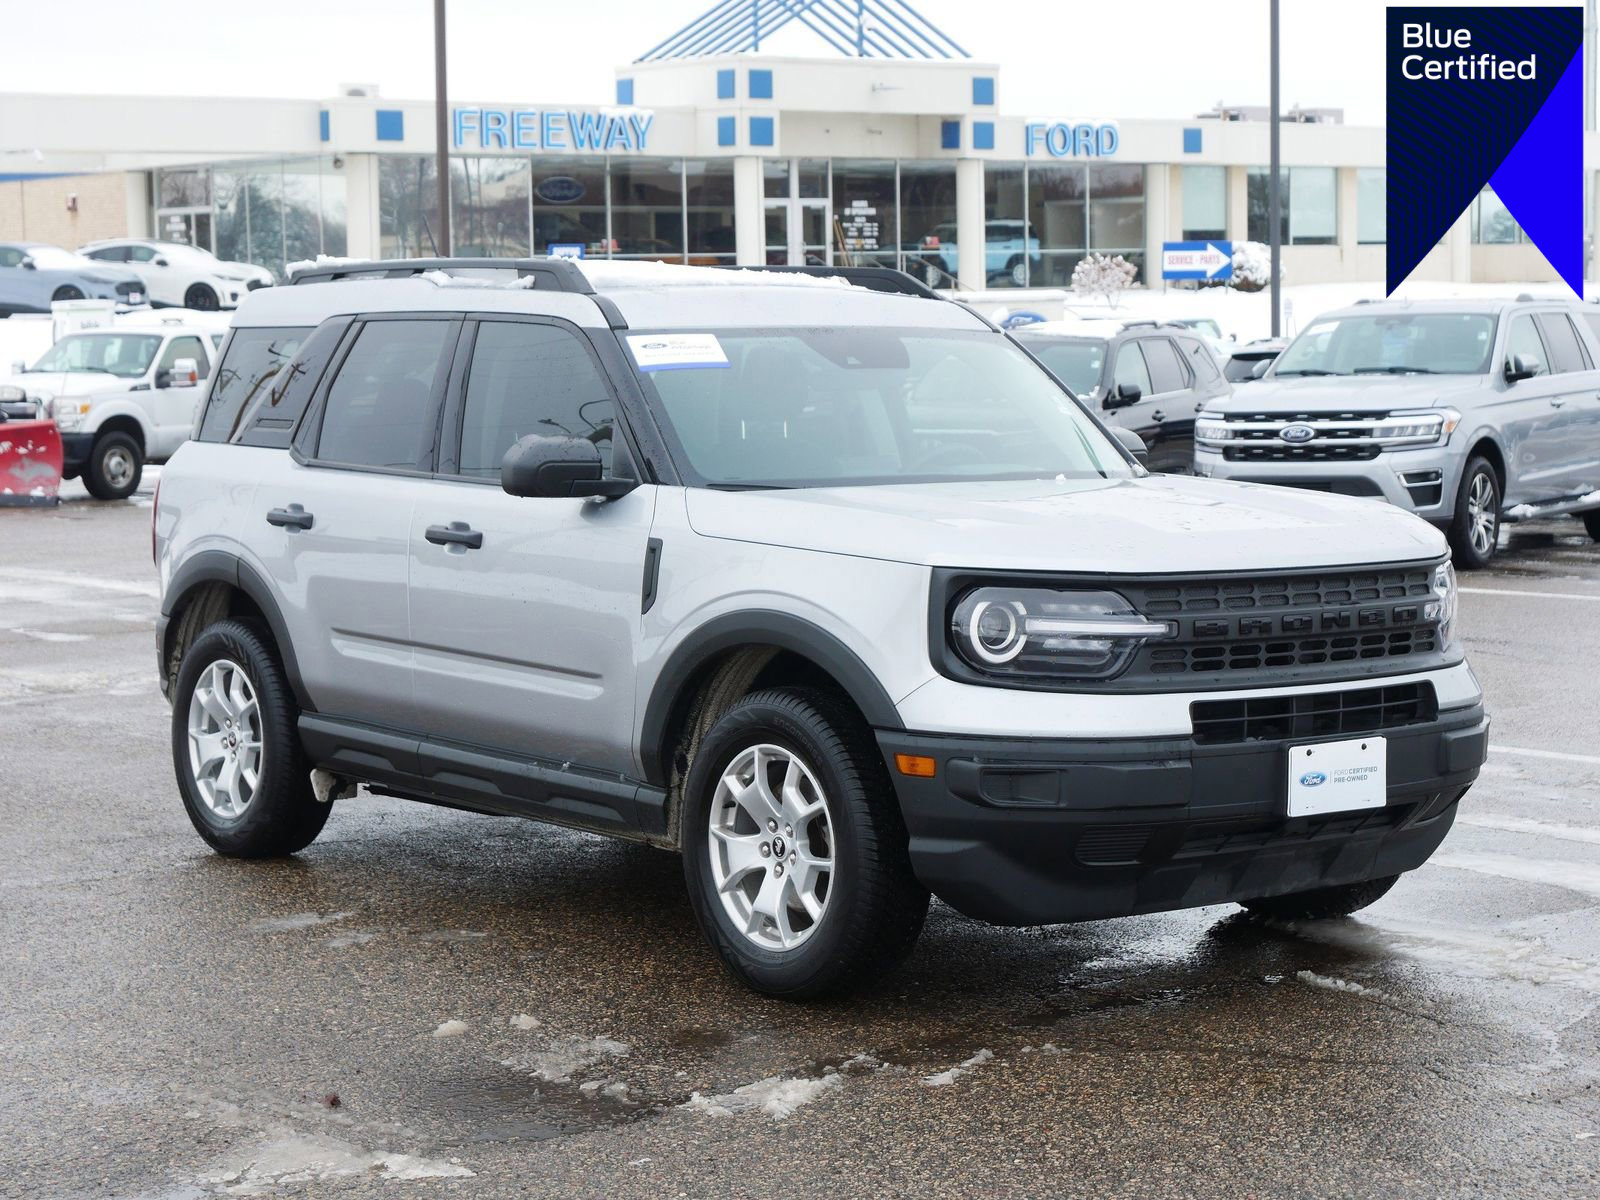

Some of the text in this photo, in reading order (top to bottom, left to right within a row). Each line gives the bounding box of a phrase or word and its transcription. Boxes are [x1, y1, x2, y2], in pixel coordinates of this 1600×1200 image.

[453, 108, 654, 152] FREEWAY
[1025, 120, 1119, 157] FORD
[1193, 606, 1418, 637] BRONCO
[1303, 773, 1322, 785] Ford
[1334, 775, 1368, 784] PRE-OWNED
